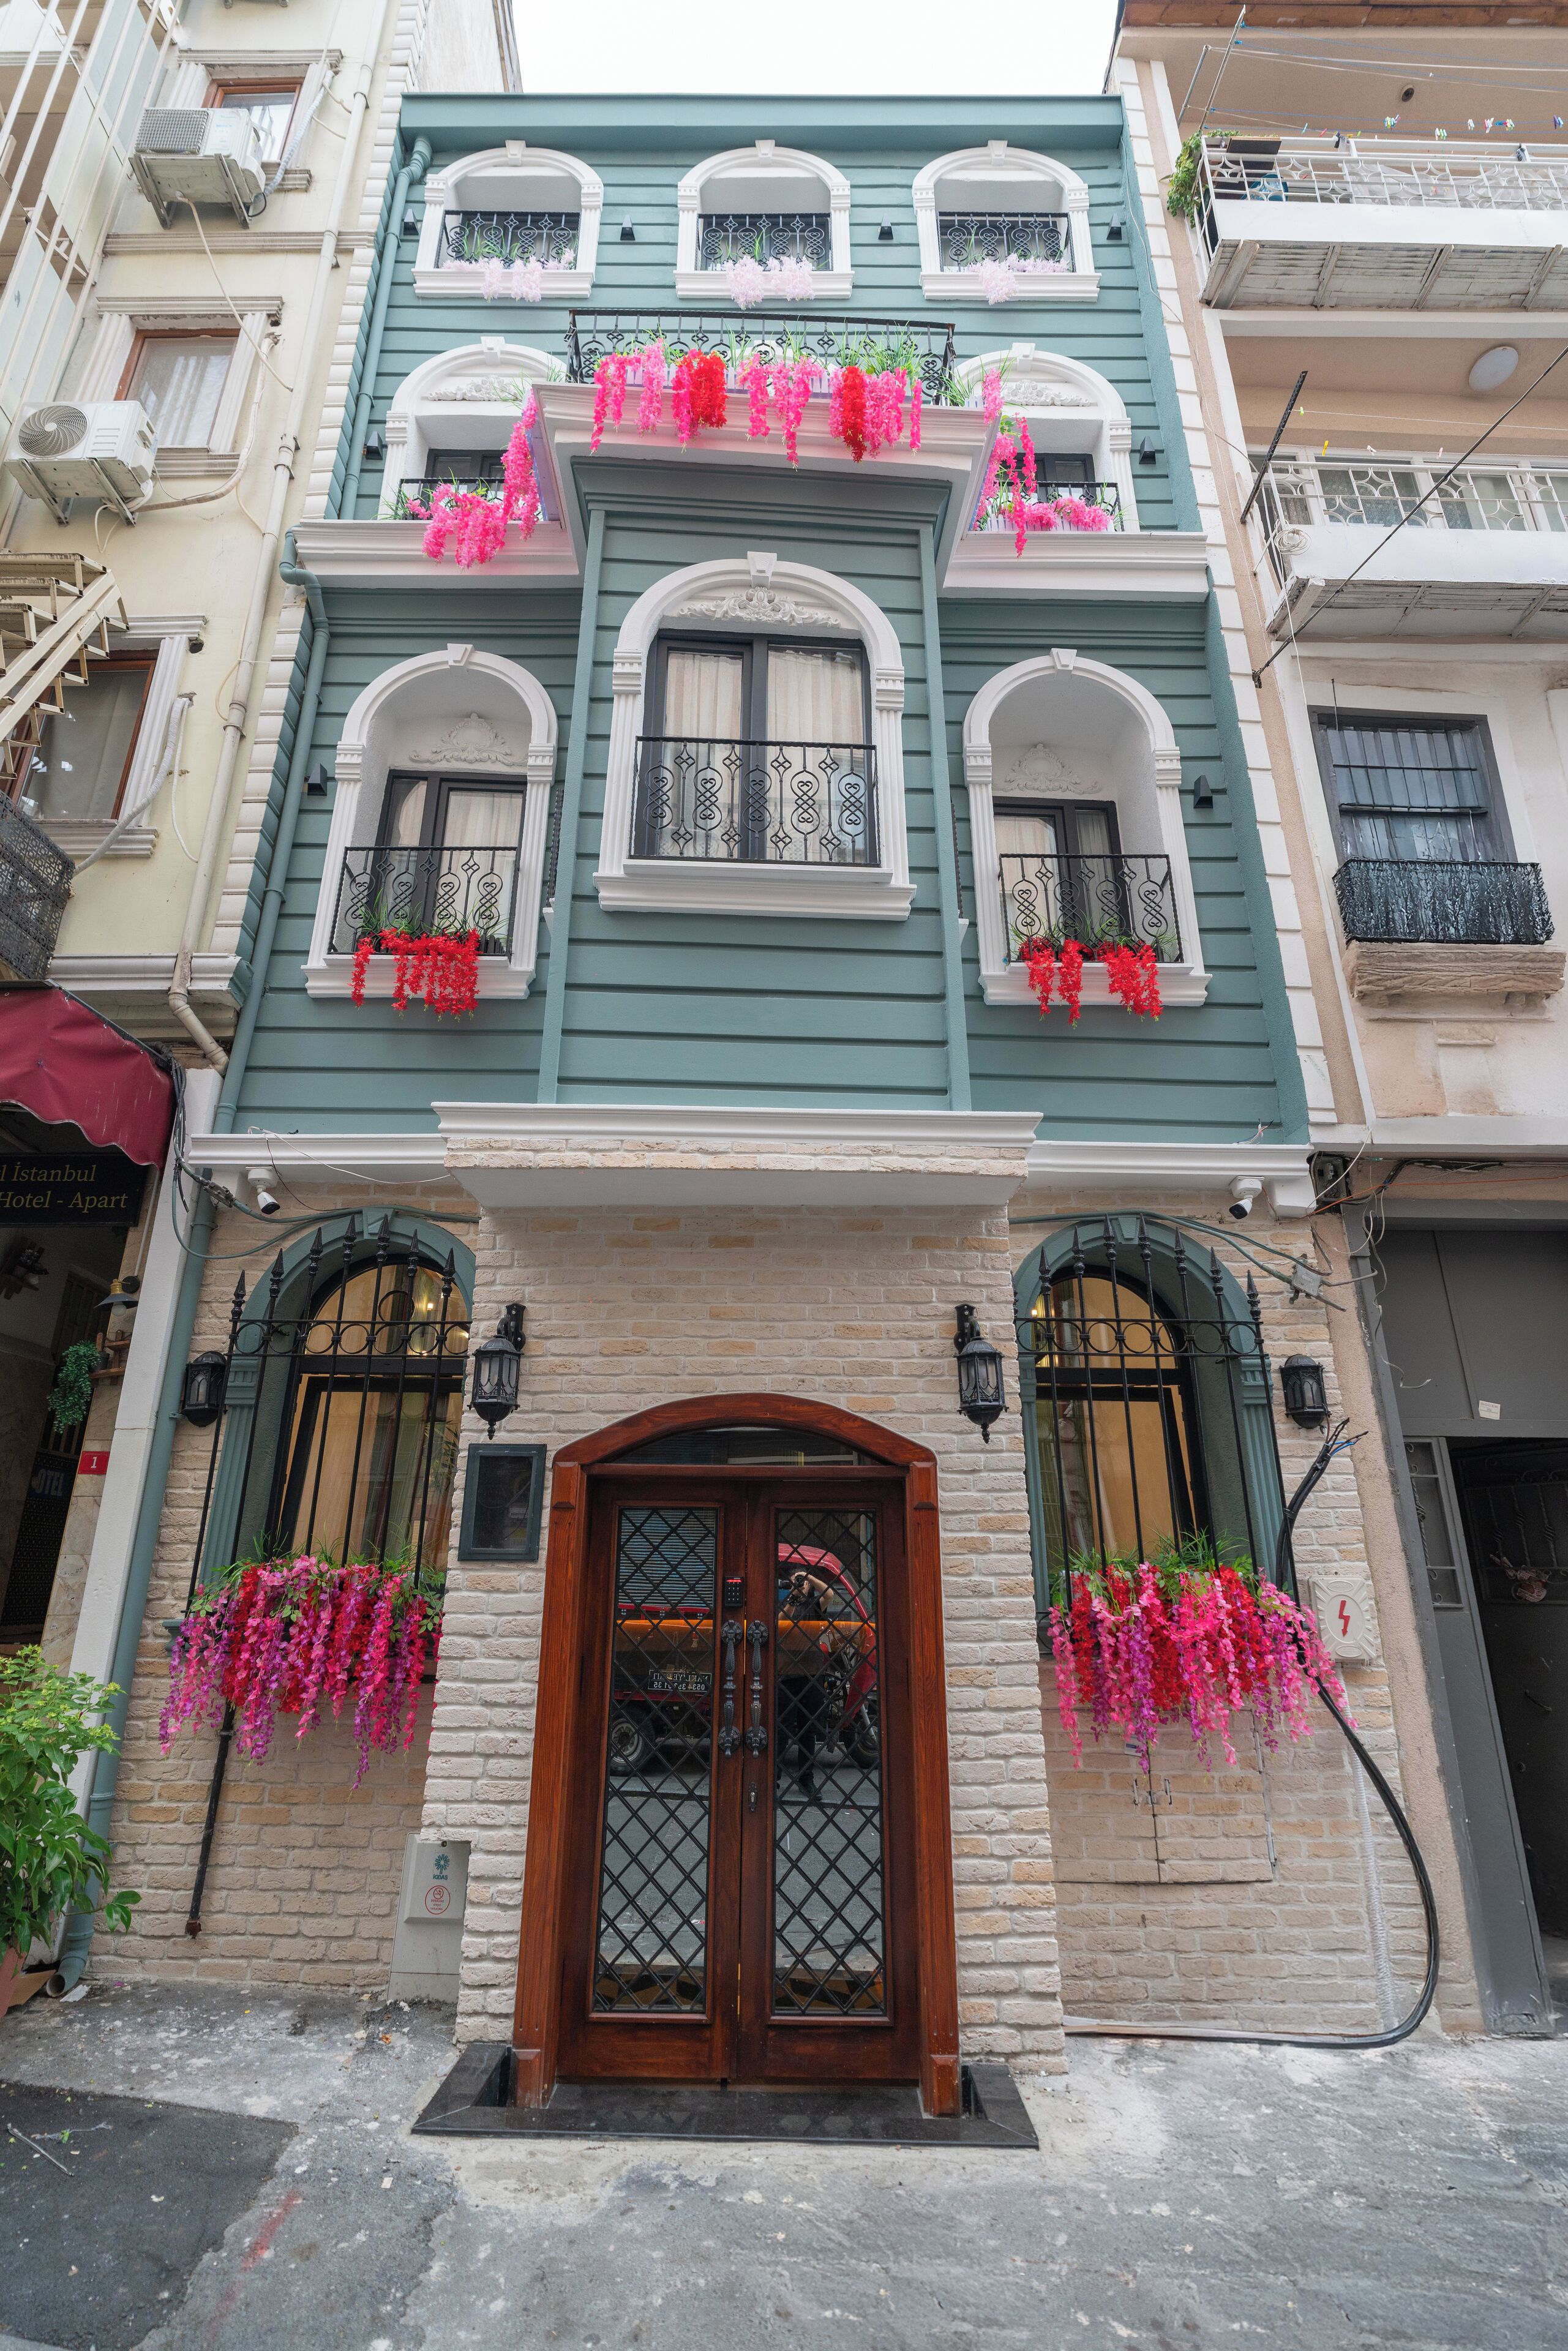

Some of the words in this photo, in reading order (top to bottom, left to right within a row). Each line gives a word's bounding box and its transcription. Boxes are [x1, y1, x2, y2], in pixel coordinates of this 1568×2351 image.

[11, 1161, 97, 1182] İstanbul
[0, 1190, 51, 1208] Hotel
[67, 1191, 128, 1213] Apart
[91, 1456, 97, 1469] 1
